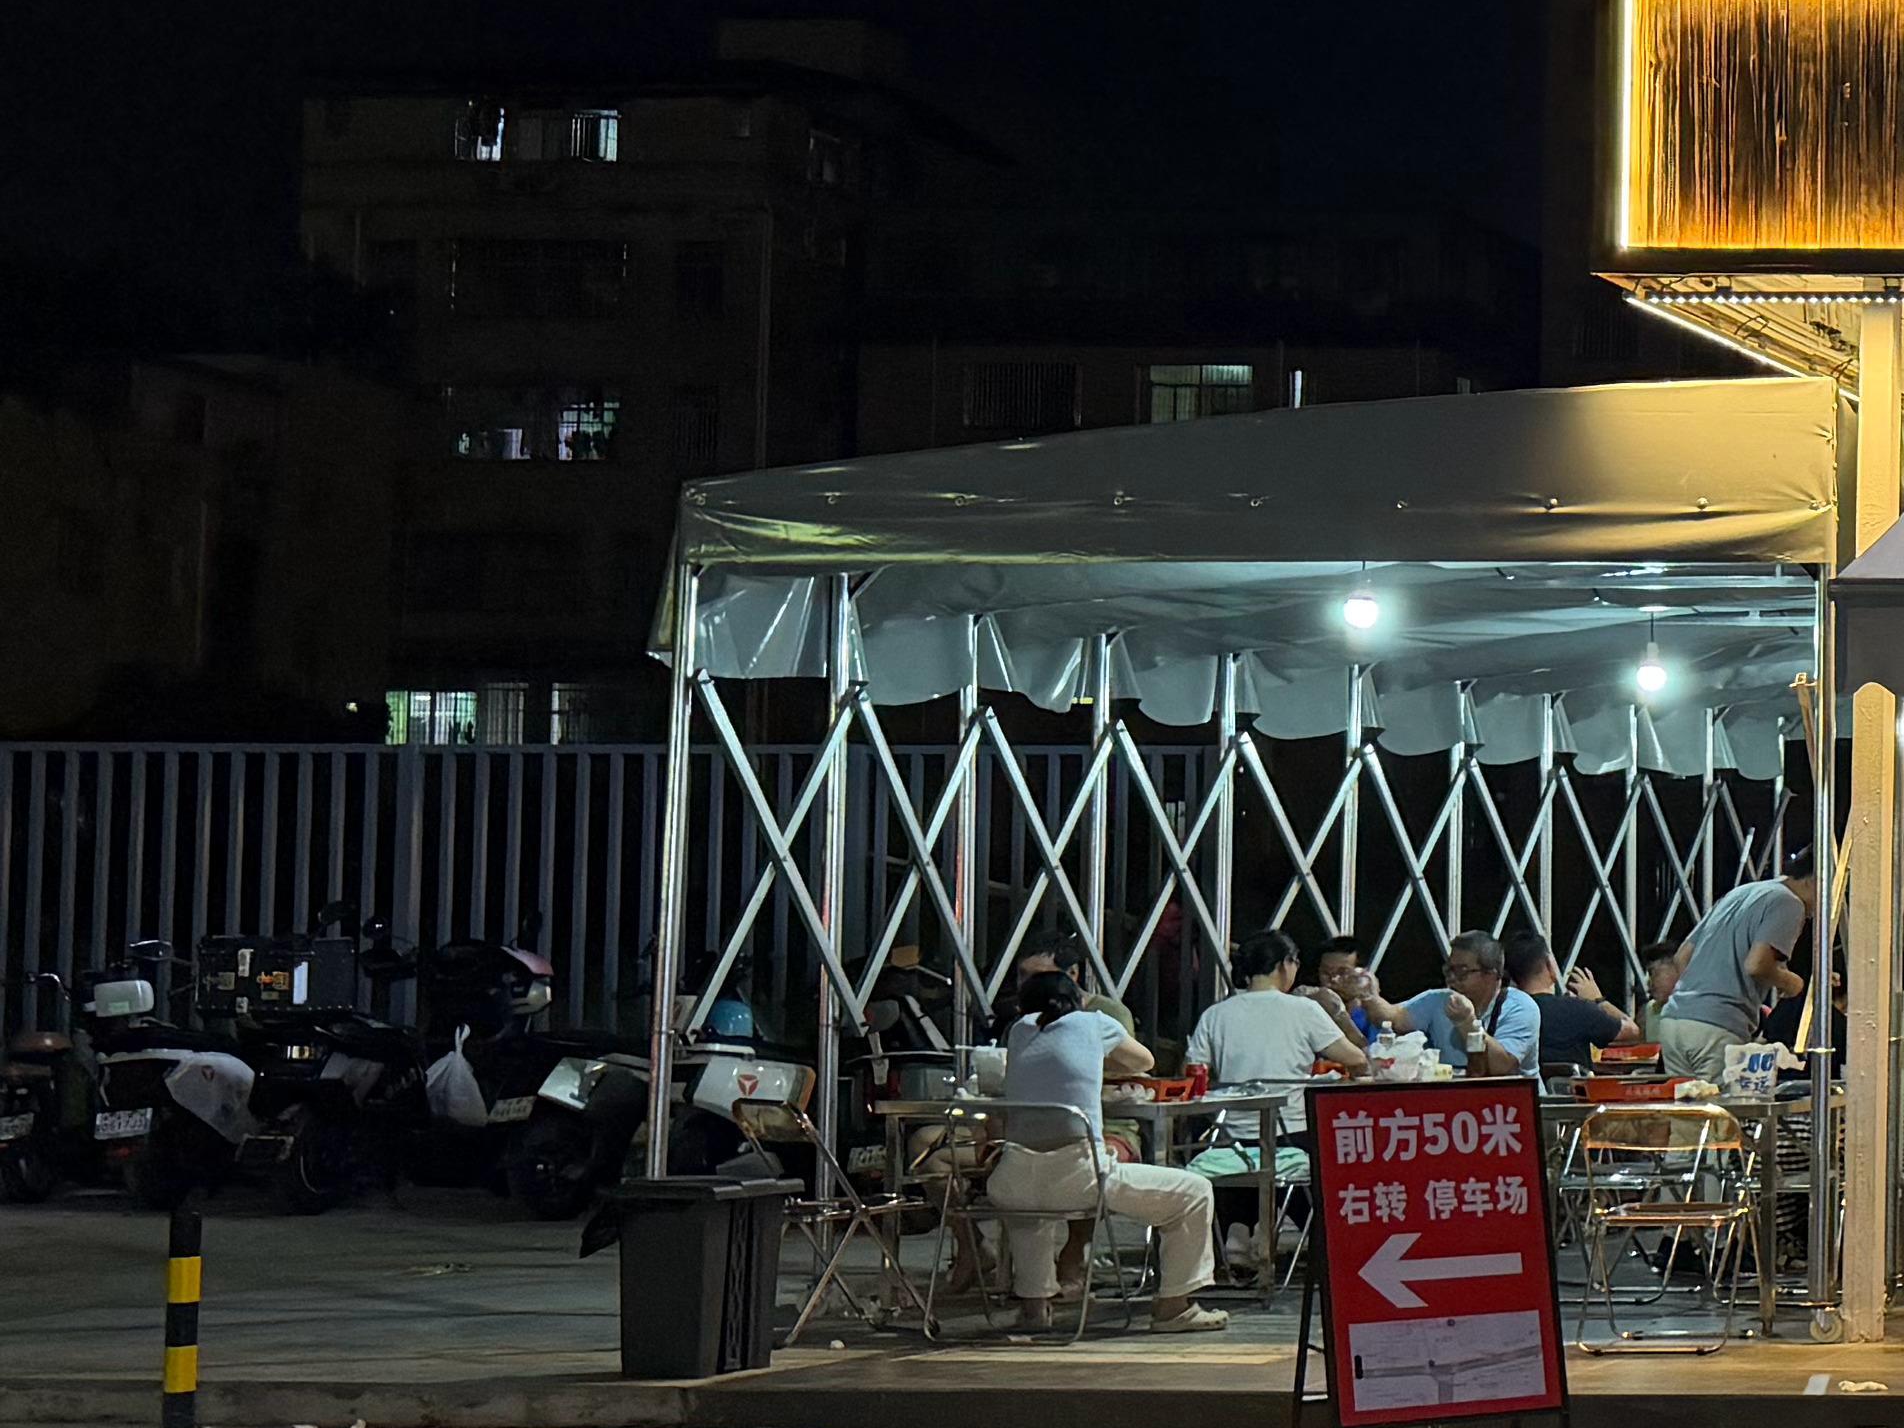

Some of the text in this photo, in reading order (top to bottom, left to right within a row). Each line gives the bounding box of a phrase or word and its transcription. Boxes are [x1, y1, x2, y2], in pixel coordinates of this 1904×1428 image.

[1332, 1103, 1523, 1165] 前方50米
[1338, 1175, 1529, 1225] 右转 停车场
